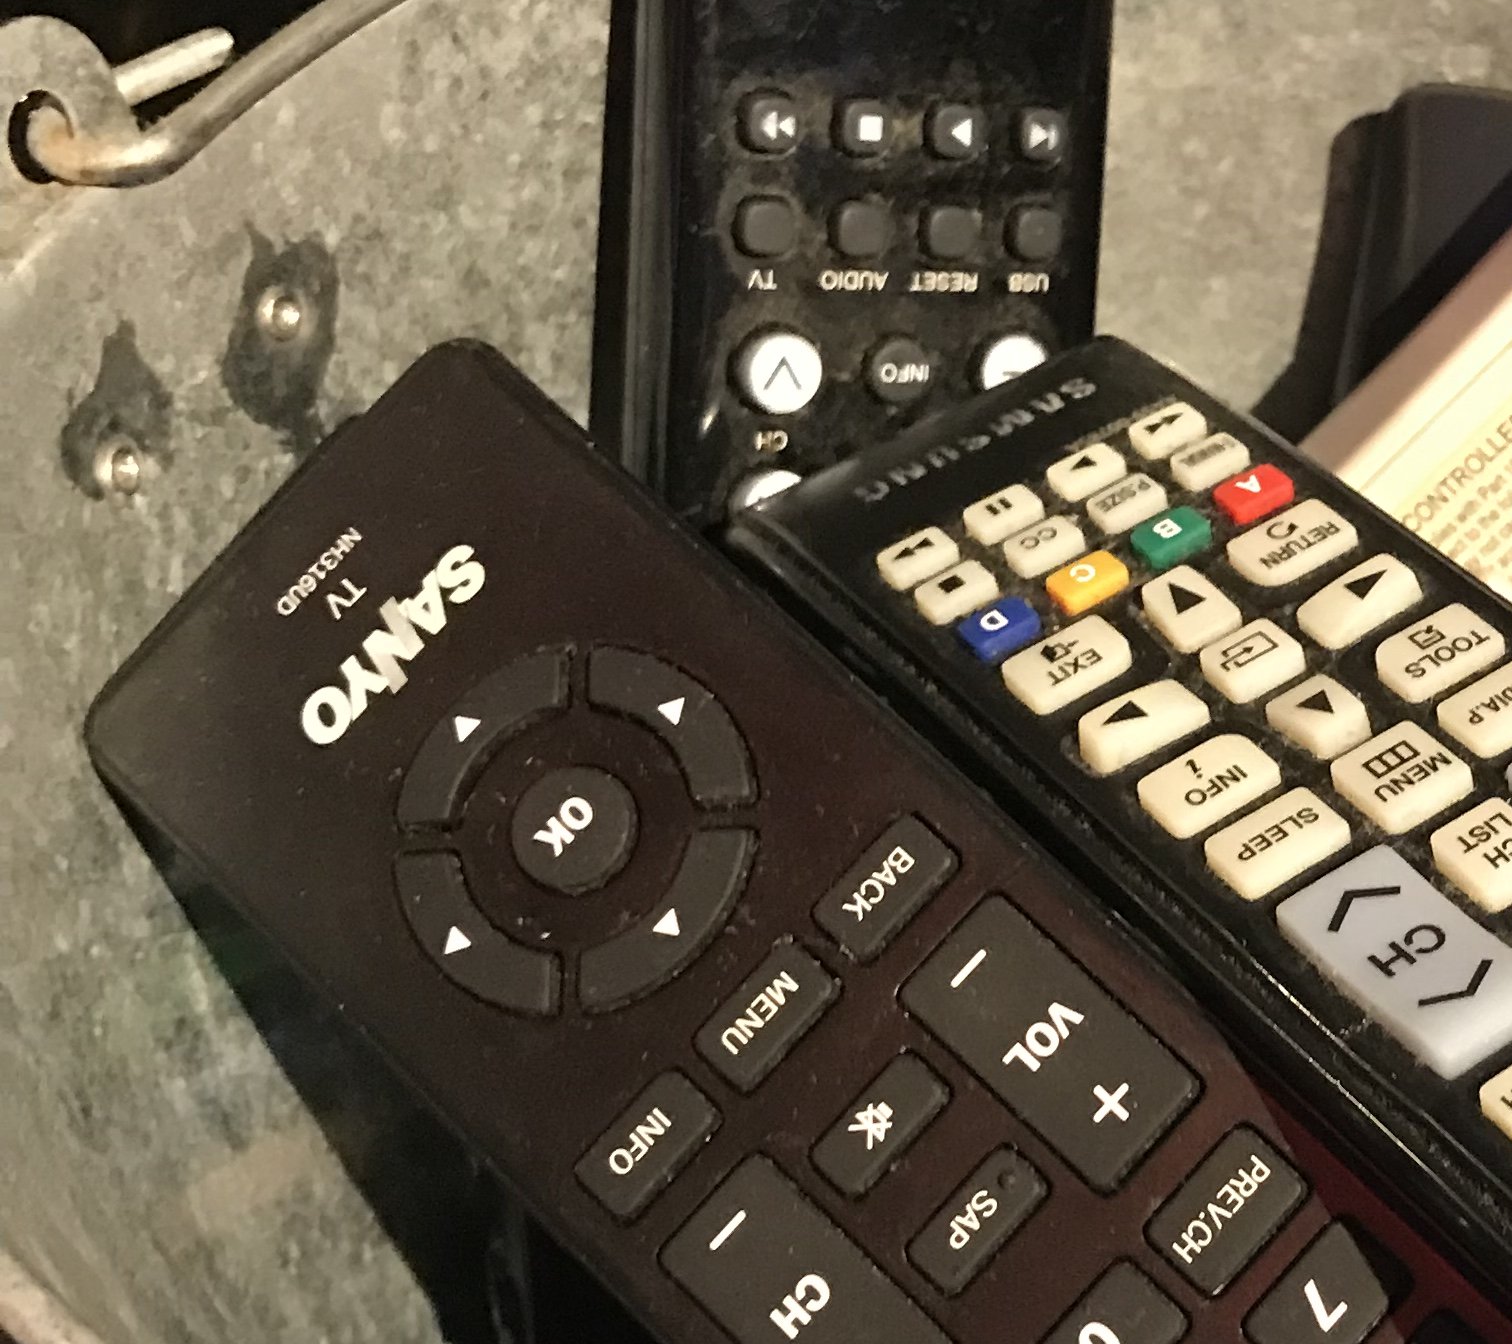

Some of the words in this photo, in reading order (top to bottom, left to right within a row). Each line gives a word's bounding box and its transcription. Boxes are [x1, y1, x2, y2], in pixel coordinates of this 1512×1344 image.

[747, 268, 778, 291] TV
[817, 269, 890, 292] AUDIO
[909, 270, 979, 293] RESET
[1007, 271, 1050, 294] USB
[879, 362, 930, 385] INFO
[755, 429, 789, 453] CH
[853, 376, 1097, 503] SAMSUNG
[1235, 473, 1262, 494] A
[1019, 526, 1058, 551] CC
[1152, 517, 1183, 539] B
[1258, 518, 1342, 572] RETURN
[325, 577, 369, 621] TV
[1069, 563, 1097, 584] C
[301, 543, 486, 746] SANYO
[979, 609, 1009, 632] D
[1047, 649, 1103, 688] EXIT
[1404, 628, 1491, 679] TOOLS
[1183, 764, 1248, 807] INFO
[1373, 750, 1453, 803] MENU
[533, 795, 595, 857] OK
[1236, 805, 1320, 862] SLEEP
[1454, 813, 1512, 854] LIST
[841, 844, 916, 922] BACK
[1367, 923, 1448, 979] CH
[720, 970, 800, 1056] MENU
[1001, 1000, 1085, 1073] VOL
[608, 1106, 673, 1176] INFO
[948, 1188, 999, 1251] SAP
[1171, 1153, 1271, 1265] PREV.CH
[769, 1273, 832, 1341] CH
[1302, 1278, 1349, 1334] 7
